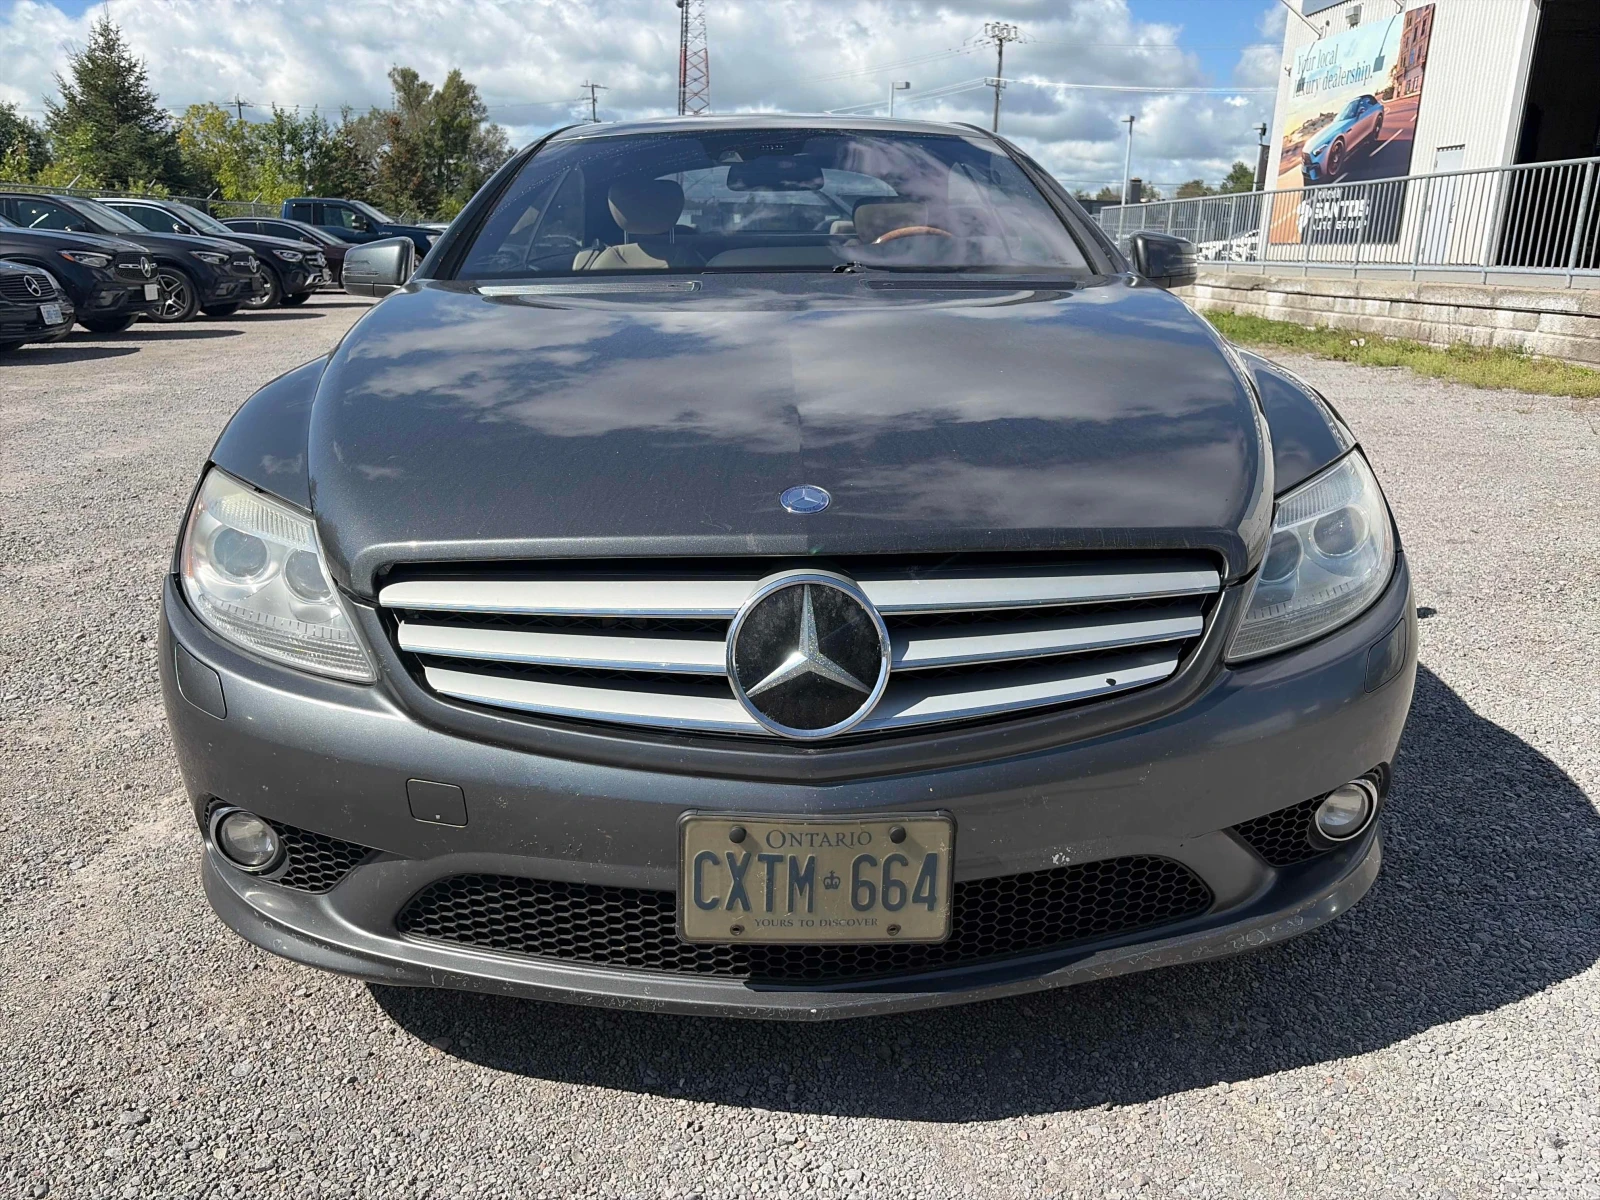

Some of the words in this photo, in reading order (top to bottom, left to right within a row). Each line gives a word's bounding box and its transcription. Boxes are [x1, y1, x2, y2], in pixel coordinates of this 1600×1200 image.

[1297, 55, 1316, 74] Your
[1317, 44, 1339, 68] local
[1322, 60, 1373, 91] dealership.
[765, 829, 872, 849] ONTARIO
[693, 850, 815, 913] CXTM
[851, 853, 938, 913] 664
[754, 917, 794, 927] YOURS
[799, 918, 815, 928] TO
[818, 917, 878, 927] DISCOVER
